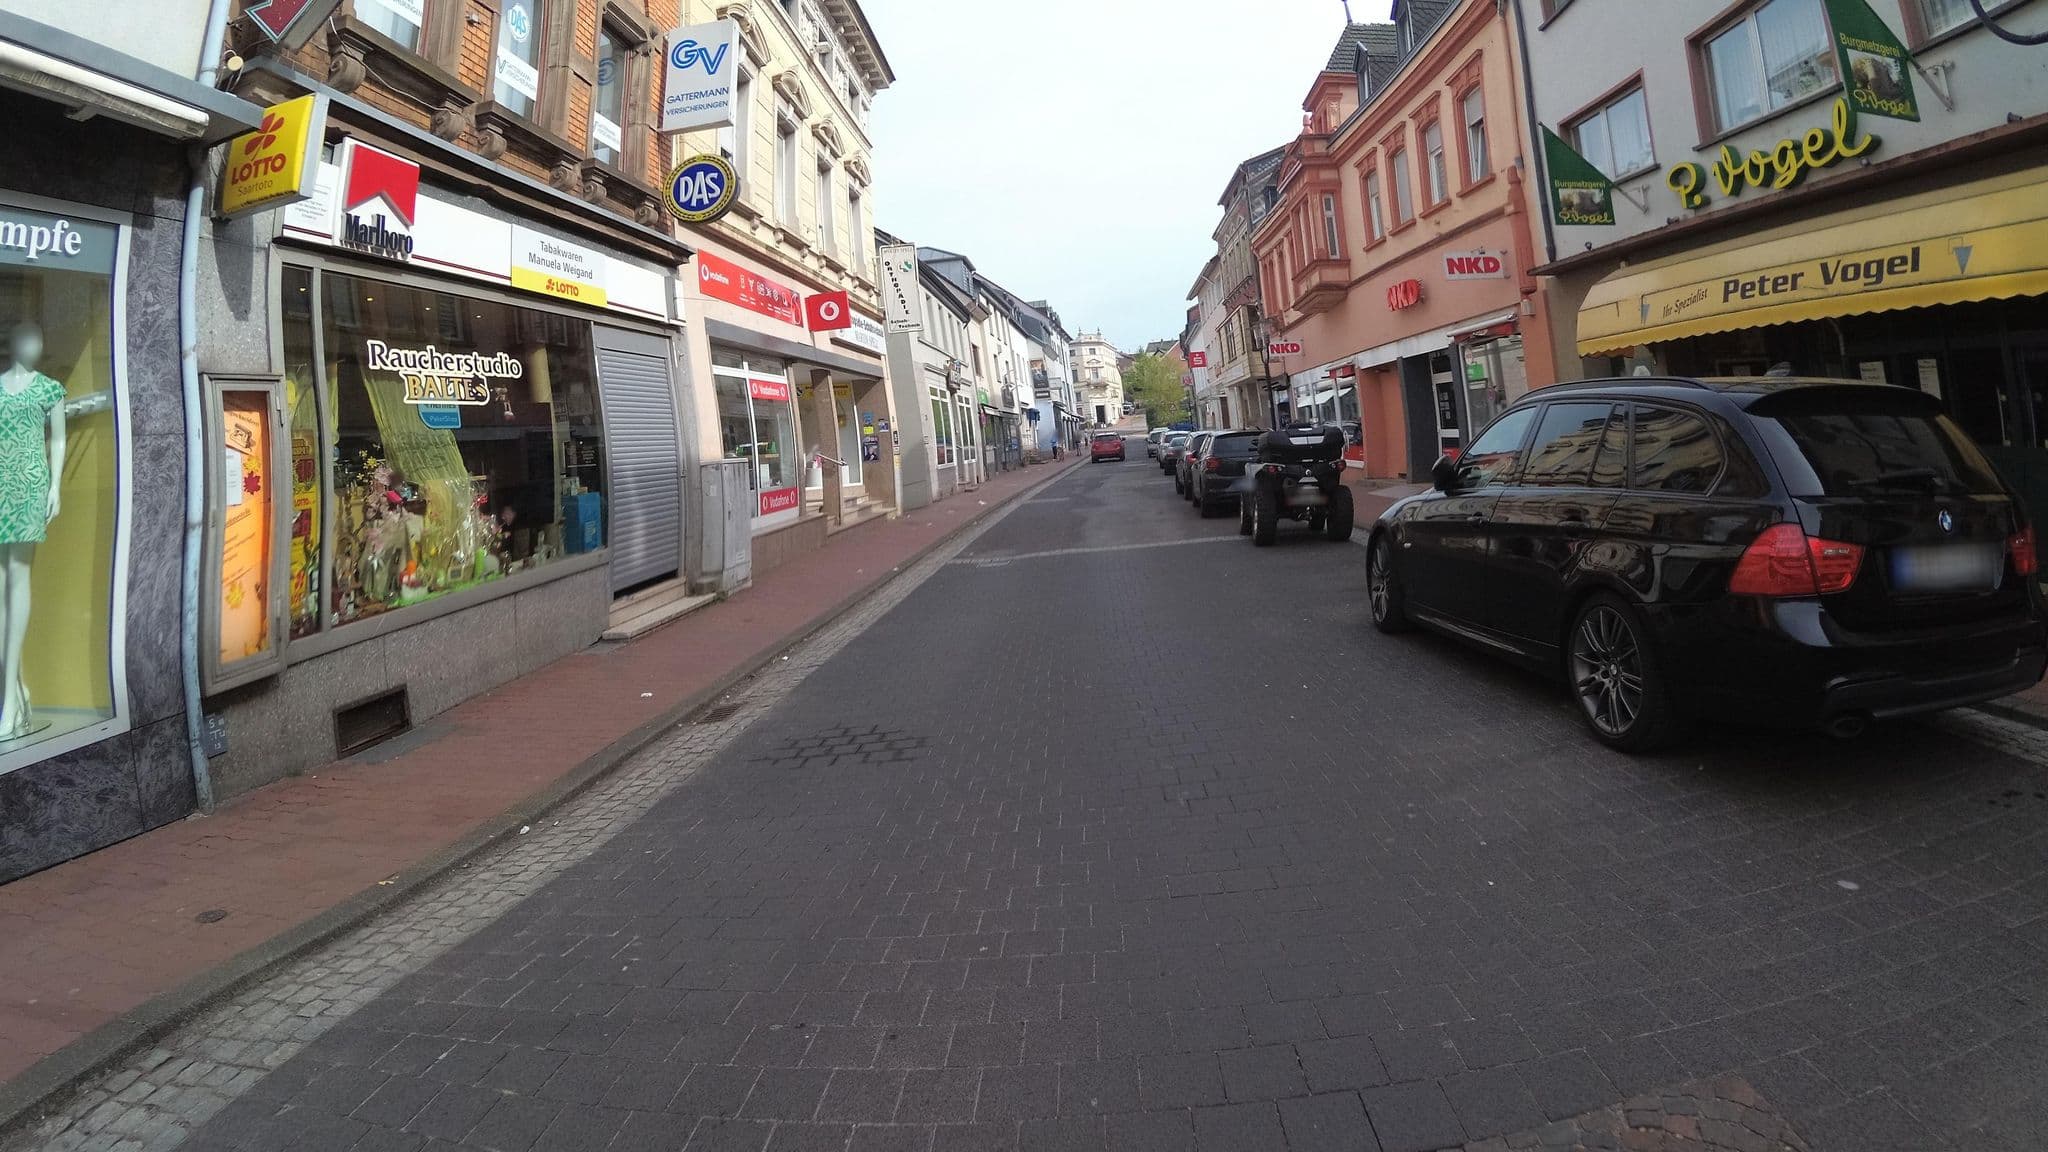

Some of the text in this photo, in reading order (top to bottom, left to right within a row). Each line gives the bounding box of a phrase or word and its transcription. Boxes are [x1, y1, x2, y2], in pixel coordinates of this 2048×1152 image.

[671, 39, 729, 75] GV
[1840, 32, 1901, 57] Burgmetzgerei
[666, 100, 728, 116] VERSICHERUNGEN
[667, 87, 729, 104] GATTERMANN
[1711, 97, 1873, 197] Vogel
[231, 153, 287, 186] LOTTO
[238, 180, 273, 197] Saartoto
[679, 171, 721, 207] DAS
[1555, 179, 1606, 189] Burgmetzgerei
[345, 213, 413, 254] Marlboro
[540, 241, 583, 263] Tabakwaren
[528, 252, 593, 280] Manuela Weigand
[1446, 257, 1500, 274] NKD
[556, 281, 580, 297] LOTTO
[1674, 288, 1708, 314] Spezialist
[1722, 272, 1805, 303] Peter
[1820, 246, 1921, 287] Vogel
[1388, 279, 1420, 311] NKD
[368, 340, 522, 378] Raucherstudio
[1270, 343, 1300, 354] NKD
[403, 372, 488, 403] BALTES
[759, 385, 780, 397] Vodafone
[769, 494, 790, 509] Vodafone
